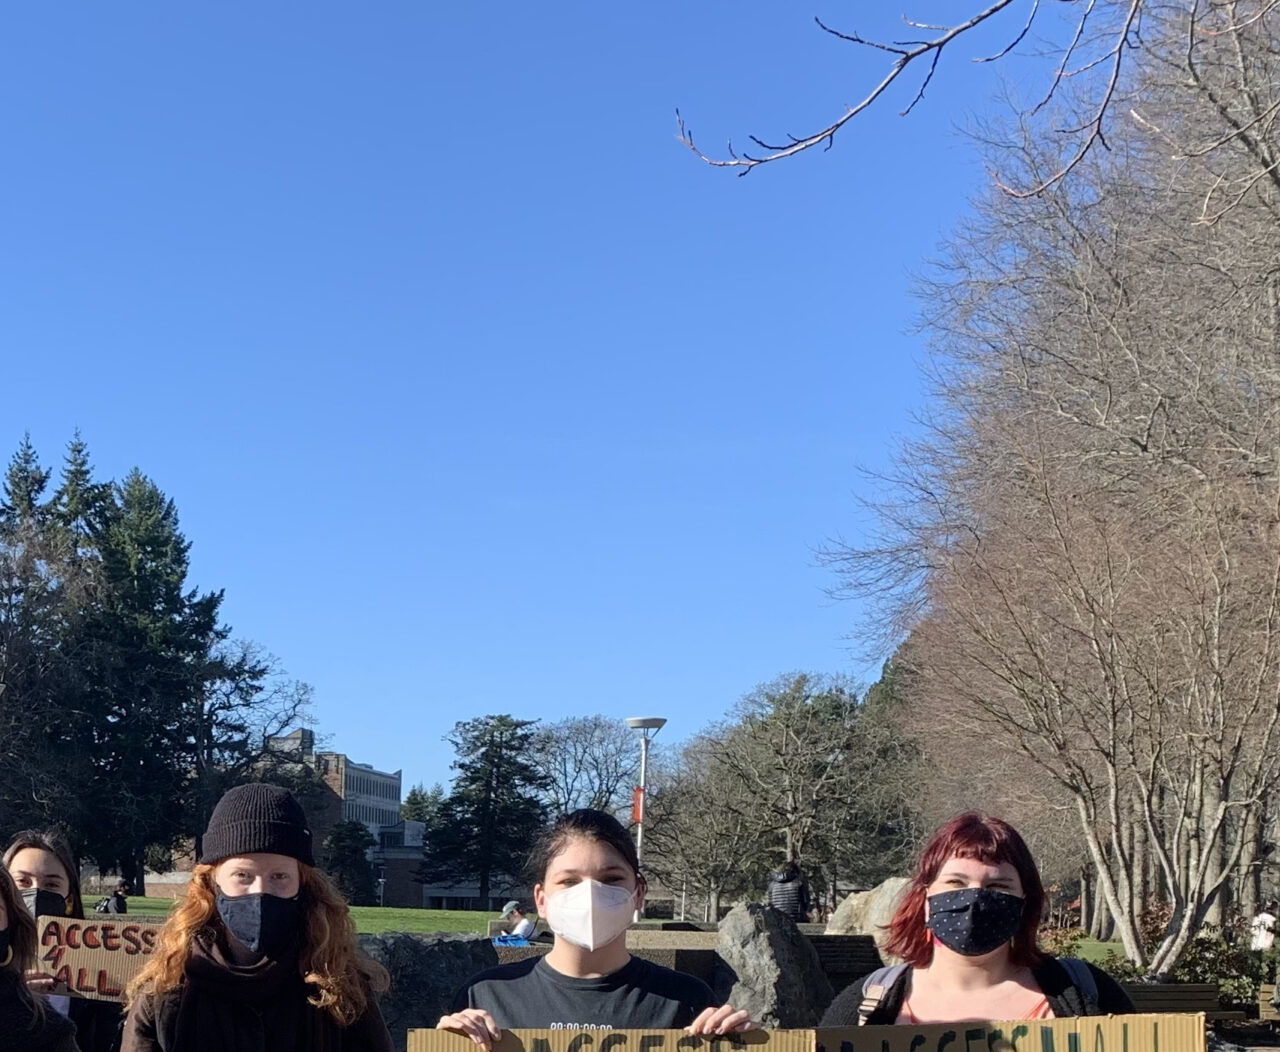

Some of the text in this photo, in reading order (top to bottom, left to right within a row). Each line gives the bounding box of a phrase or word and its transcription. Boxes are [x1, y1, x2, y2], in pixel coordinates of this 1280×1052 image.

[41, 921, 158, 955] ACCESS
[43, 945, 66, 969] 4
[56, 964, 121, 996] ALL
